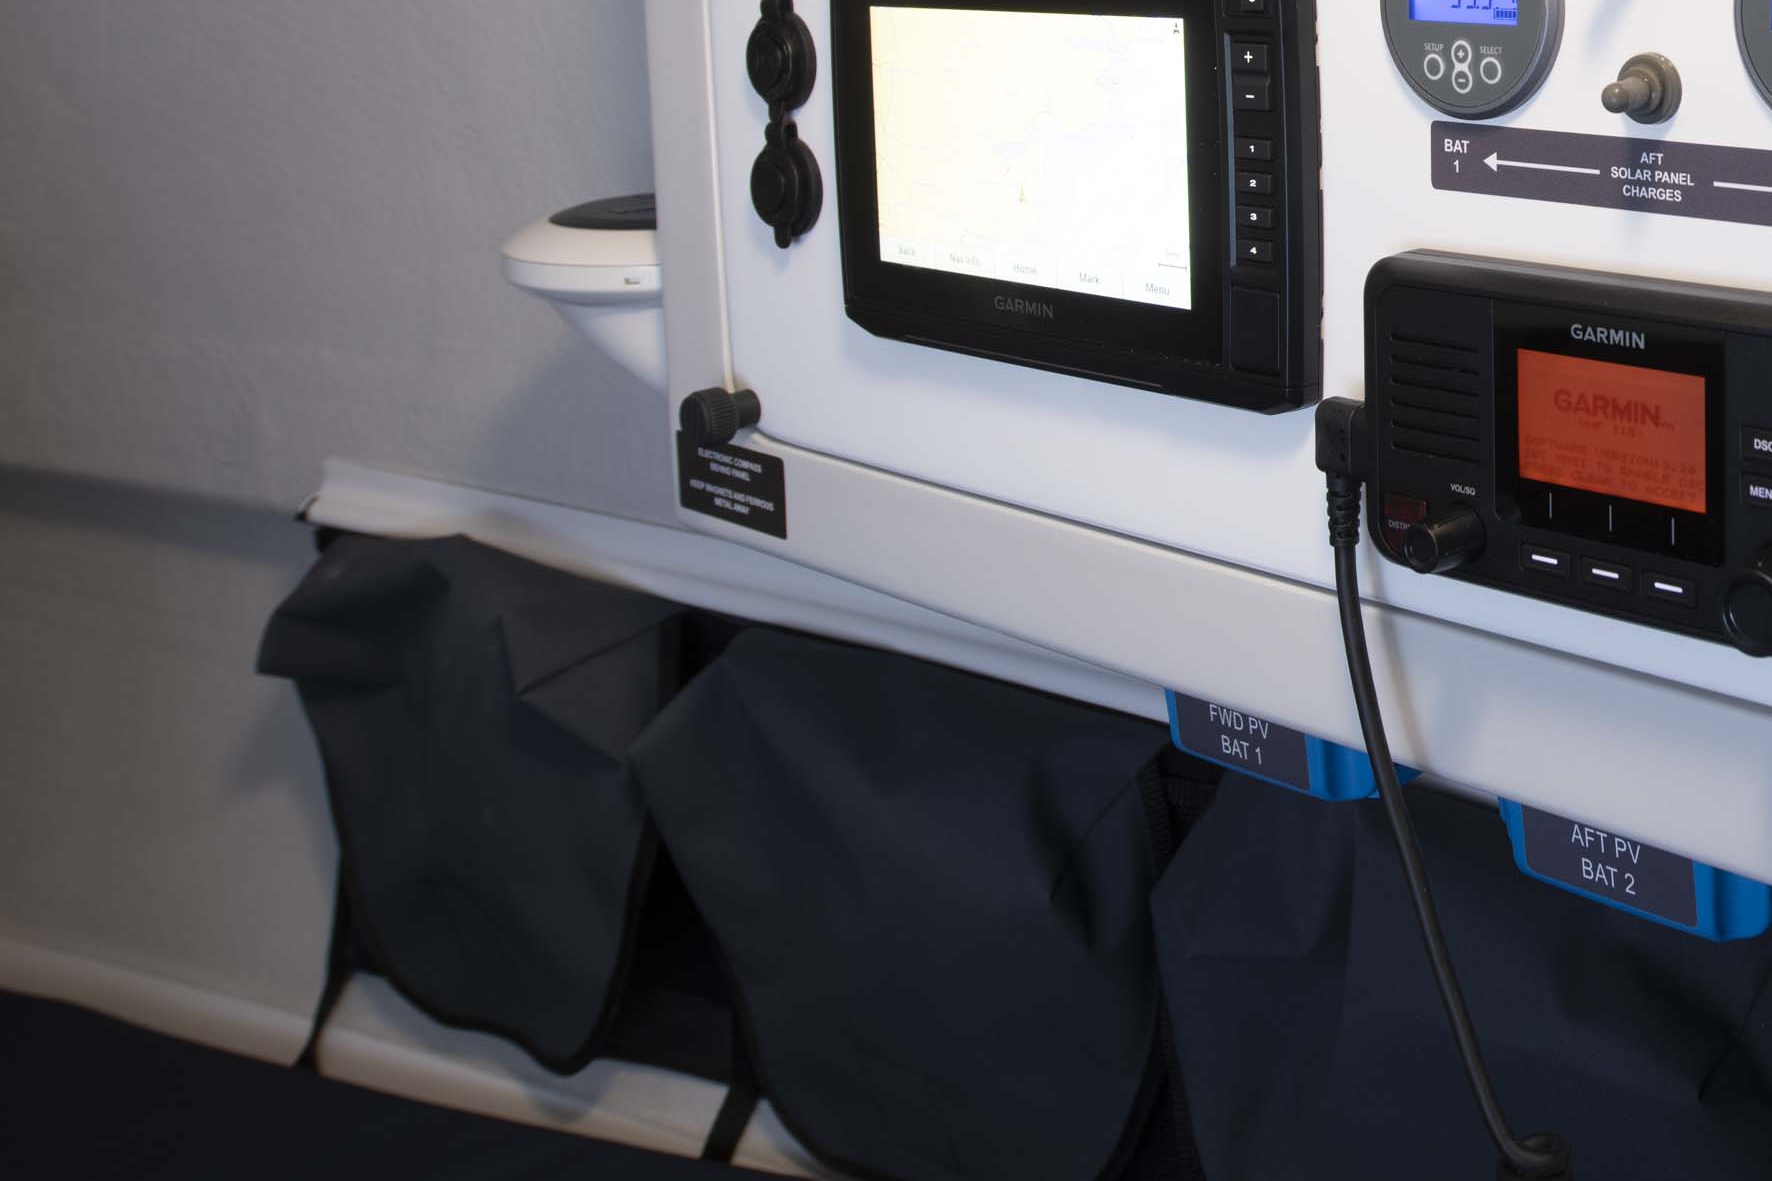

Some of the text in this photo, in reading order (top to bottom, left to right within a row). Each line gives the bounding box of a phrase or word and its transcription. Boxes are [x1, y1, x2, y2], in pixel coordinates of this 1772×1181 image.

[1424, 43, 1444, 51] SETUP
[1480, 46, 1502, 55] SELECT
[1249, 145, 1255, 154] 1
[1444, 138, 1470, 154] BAT
[1640, 152, 1664, 165] AFT
[1453, 160, 1460, 173] 1
[1610, 166, 1695, 186] SOLAR PANEL
[1249, 179, 1256, 188] 2
[1622, 185, 1682, 202] CHARGES
[1250, 213, 1257, 221] 3
[1250, 246, 1257, 255] 4
[1013, 262, 1038, 276] Home
[1079, 271, 1099, 286] Mark
[1145, 282, 1171, 296] Menu
[994, 295, 1054, 319] GARMIN
[1570, 323, 1645, 349] GARMIN
[1553, 388, 1662, 427] GARMIN
[1449, 483, 1476, 496] VOL/SQ
[1208, 703, 1269, 739] FWD PV
[1221, 734, 1262, 765] BAT 1
[1571, 823, 1641, 864] AFT PV
[1581, 857, 1636, 895] BAT 2
